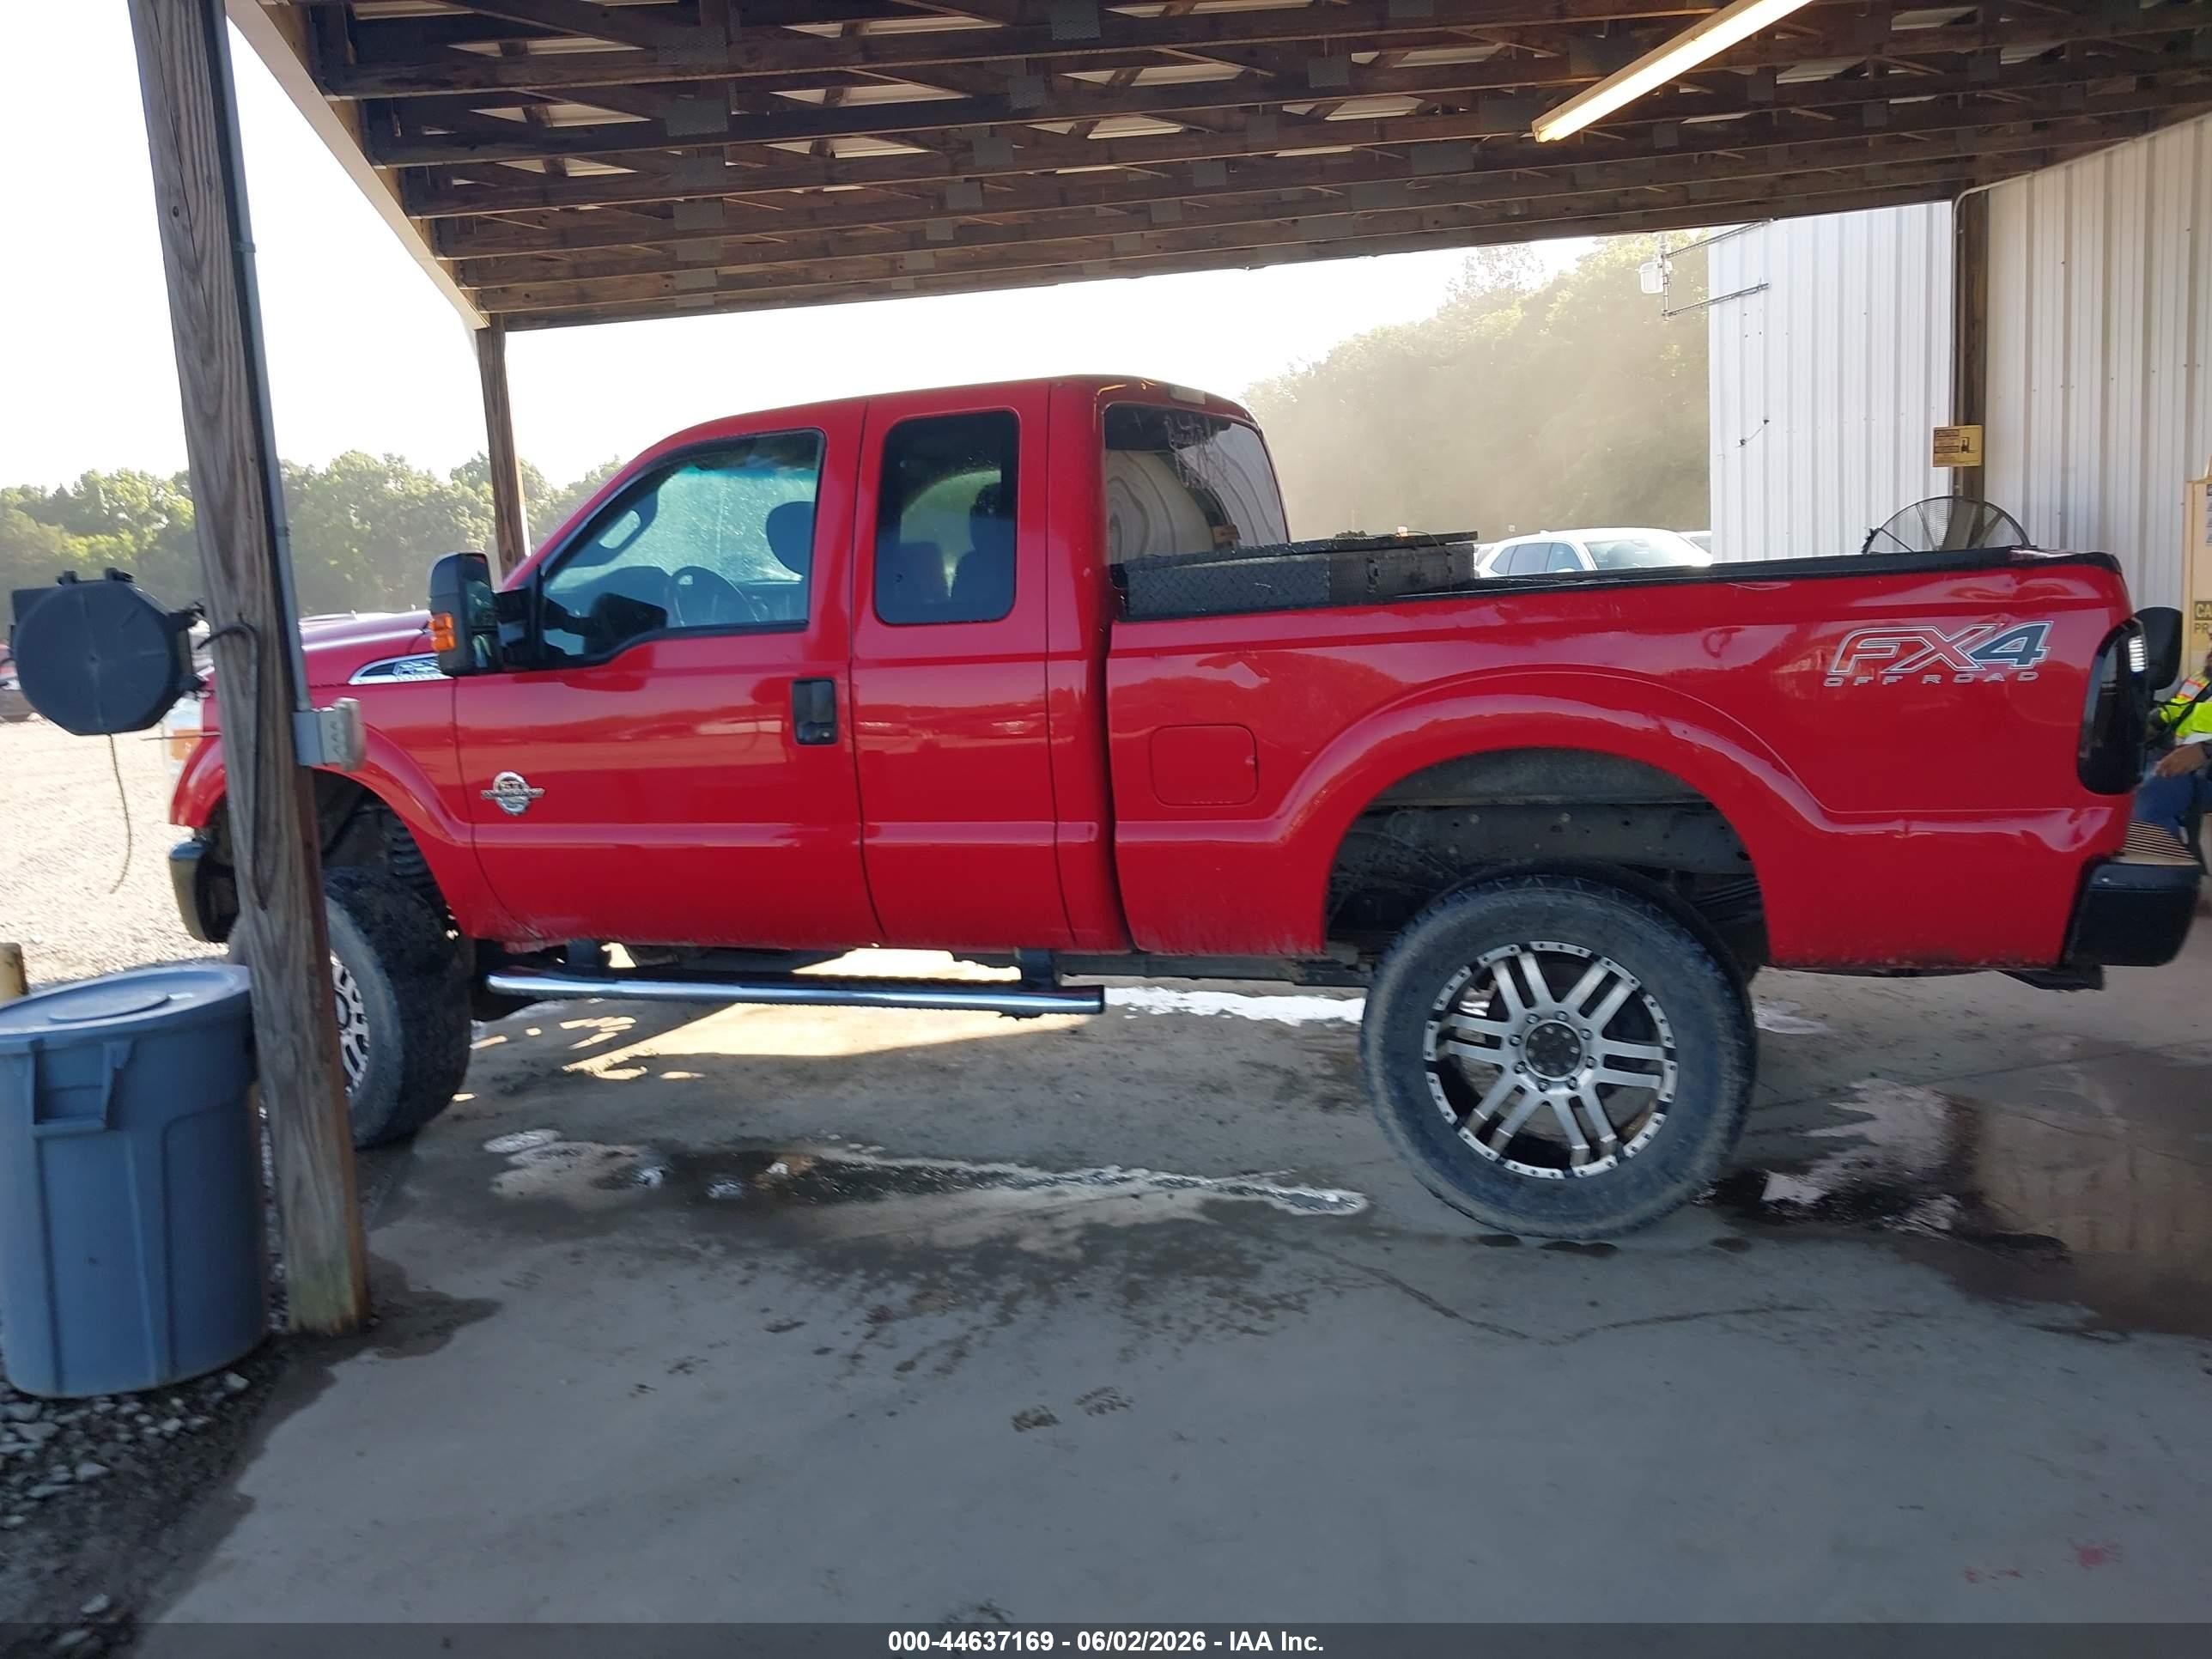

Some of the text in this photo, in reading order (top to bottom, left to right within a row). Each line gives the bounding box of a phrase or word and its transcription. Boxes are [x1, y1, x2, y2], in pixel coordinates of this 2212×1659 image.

[1826, 621, 2054, 675] FX4
[1823, 671, 2039, 687] OFF ROAD
